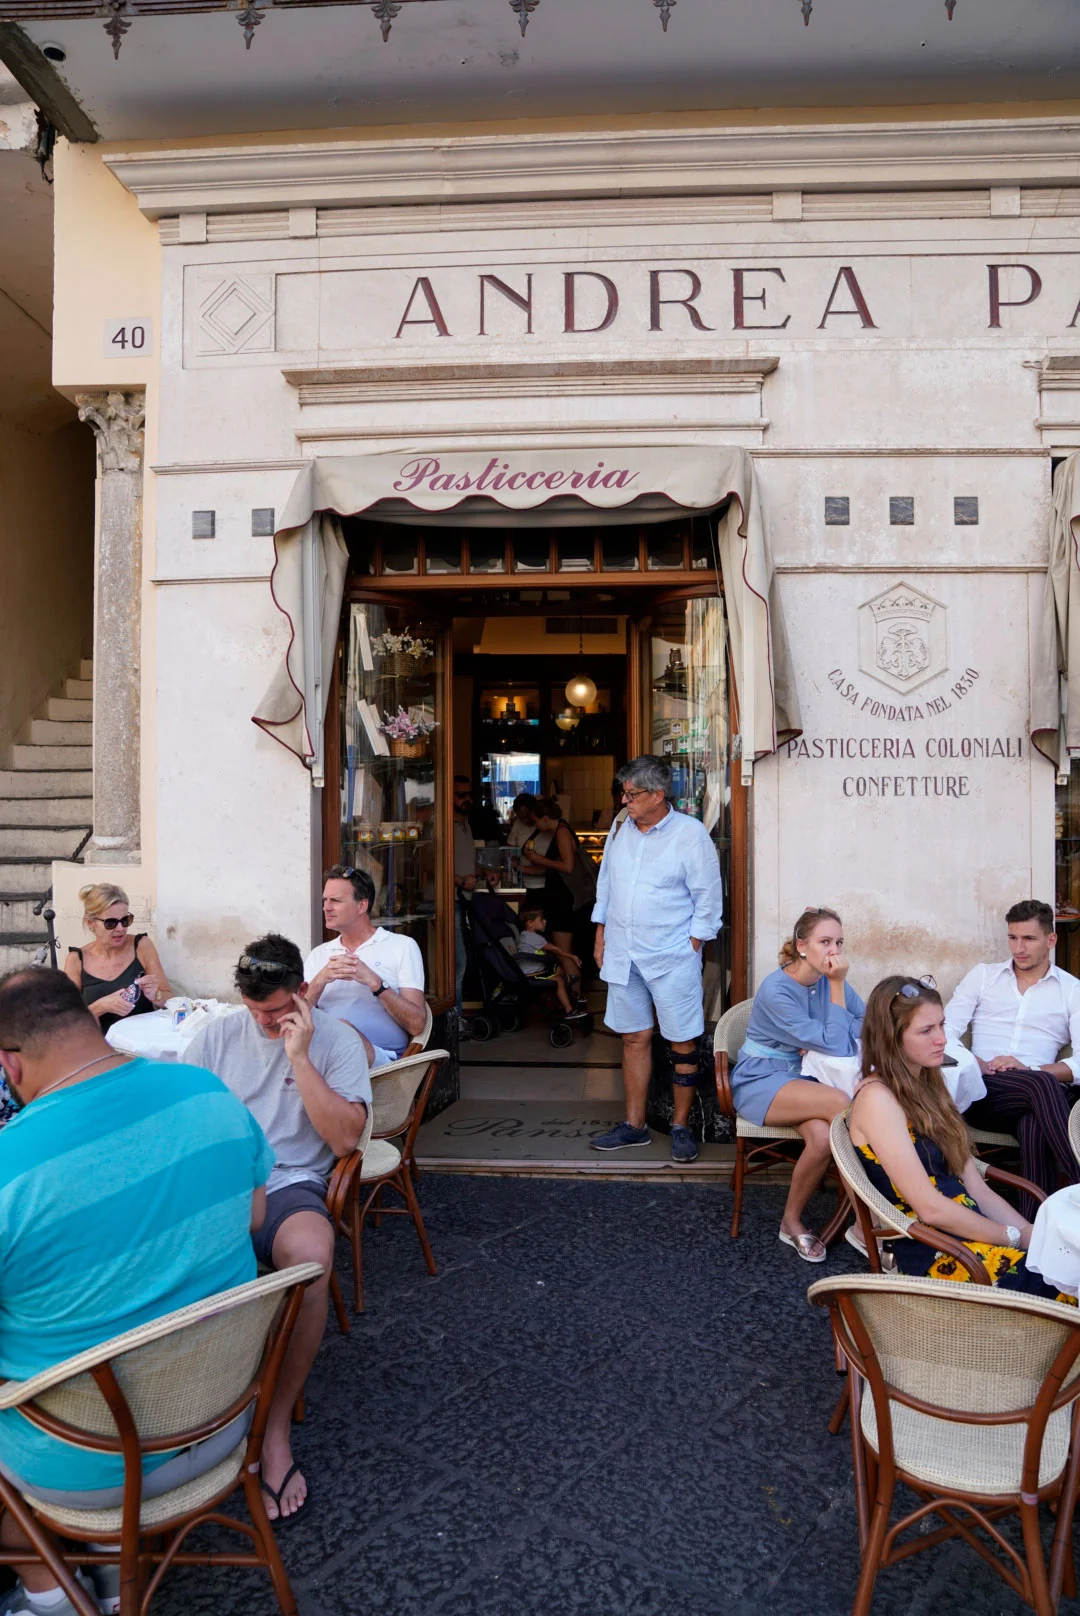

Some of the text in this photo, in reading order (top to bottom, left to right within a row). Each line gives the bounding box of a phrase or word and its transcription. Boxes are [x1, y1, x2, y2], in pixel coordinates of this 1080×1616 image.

[393, 266, 879, 339] ANDREA
[112, 326, 145, 350] 40
[393, 457, 641, 492] Pasticceria
[828, 667, 981, 722] CASA FONDATA NEL 1830
[787, 737, 1023, 760] PASTICCERIA COLONIALI
[842, 775, 970, 799] CONFETTURE
